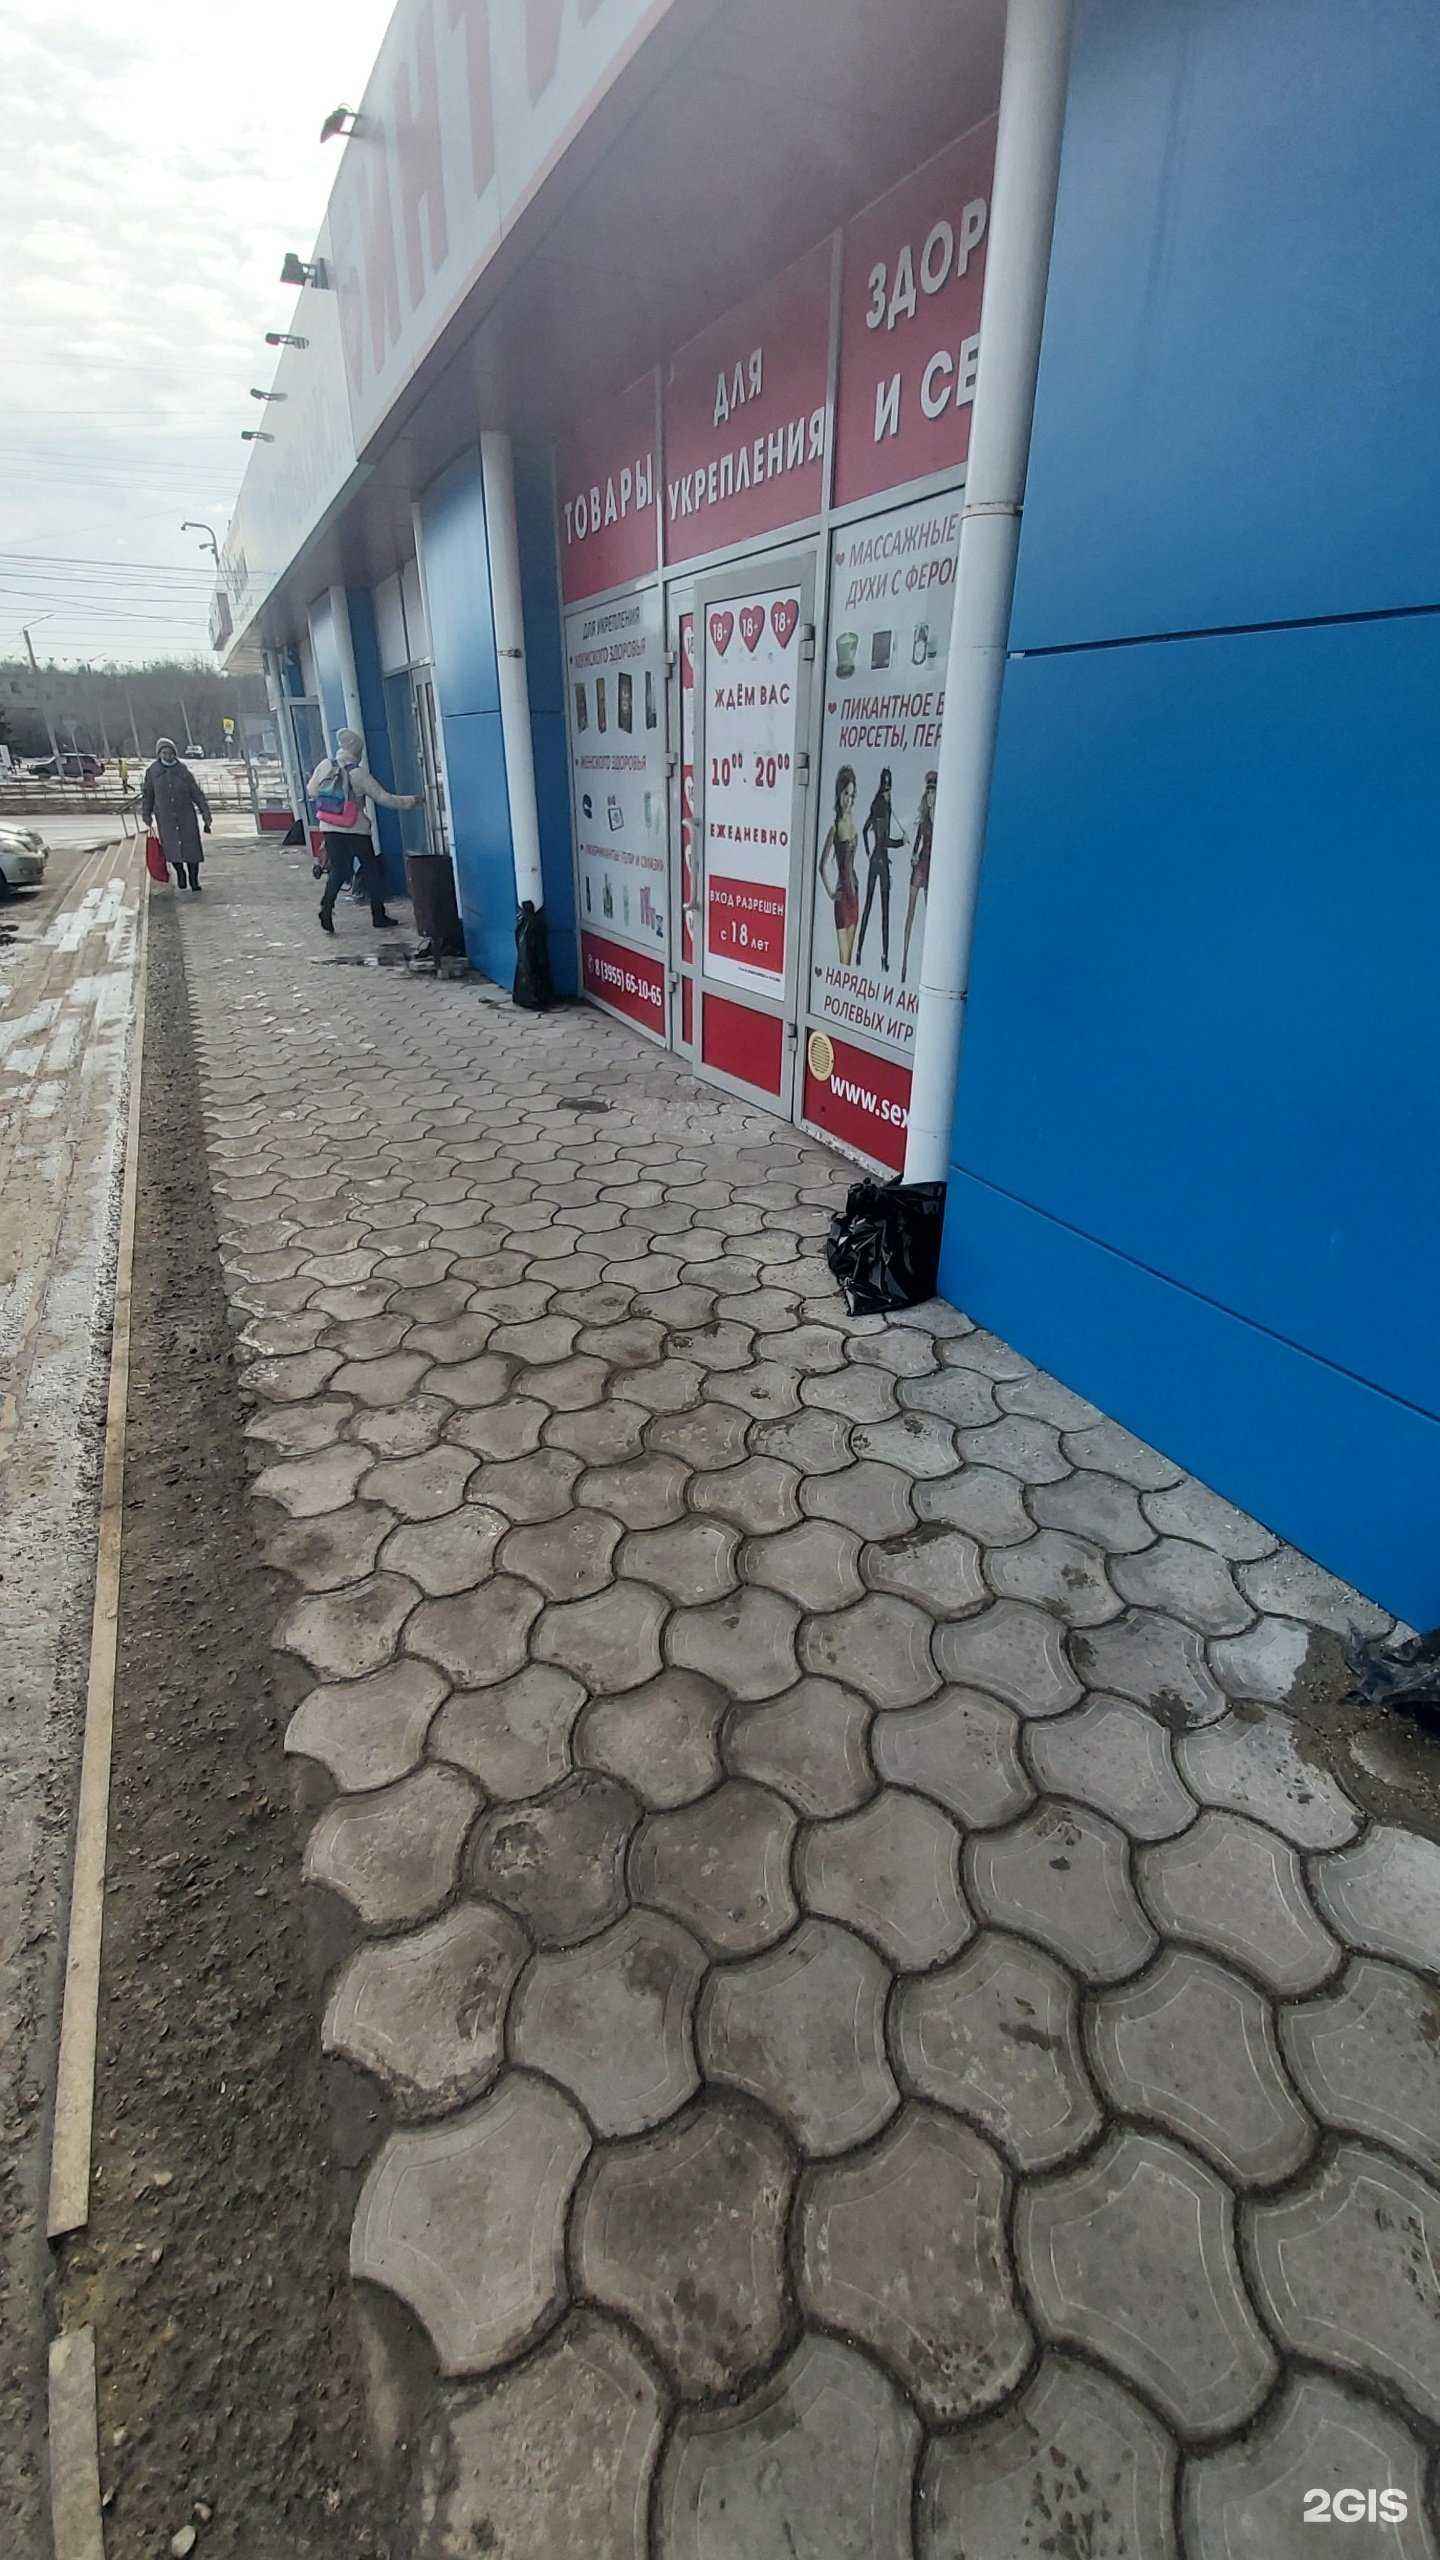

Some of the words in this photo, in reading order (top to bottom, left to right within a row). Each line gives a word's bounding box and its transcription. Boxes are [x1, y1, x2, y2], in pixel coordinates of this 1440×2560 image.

[866, 198, 987, 330] ЗДОР
[713, 347, 763, 427] ДЛЯ
[874, 371, 901, 442] И
[667, 406, 825, 521] УКРЕПЛЕНИЯ
[563, 453, 654, 544] ТОВАРЫ
[849, 512, 959, 567] МАССАЖНЫЕ
[845, 573, 888, 610] ДУХИ
[891, 570, 902, 595] С
[715, 683, 755, 711] ЖДЁМ
[760, 683, 790, 705] ВАС
[841, 692, 933, 720] ПИКАНТНОЕ
[839, 724, 908, 752] КОРСЕТЫ,
[710, 823, 788, 847] ЕЖЕДНЕВНО
[710, 890, 734, 908] ВХОД
[736, 895, 784, 916] РАЗРЕШЕН
[731, 920, 748, 946] 18
[750, 938, 769, 952] лет
[594, 958, 601, 977] 8
[601, 960, 625, 992] (3955)
[625, 972, 662, 1007] 65-10-65
[825, 967, 880, 1000] НАРЯДЫ
[883, 985, 894, 1004] И
[824, 996, 885, 1033] РОЛЕВЫХ
[887, 1018, 914, 1042] ИГР
